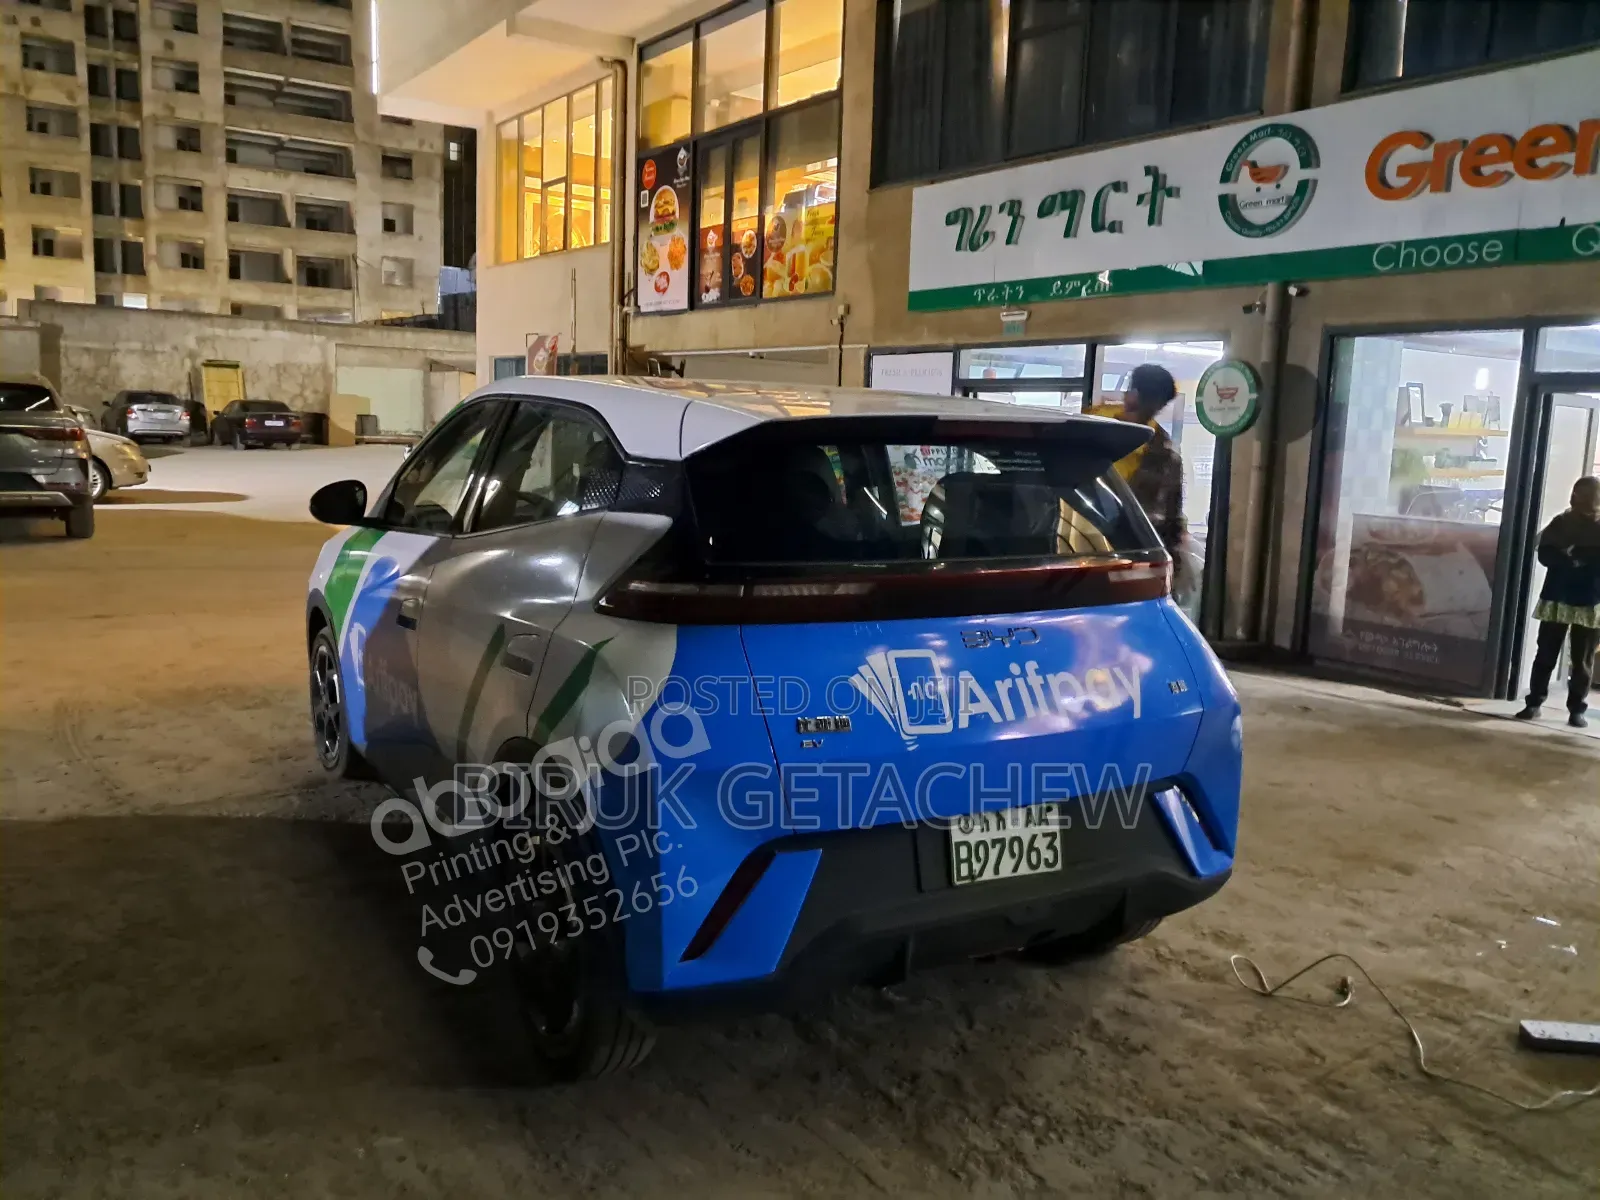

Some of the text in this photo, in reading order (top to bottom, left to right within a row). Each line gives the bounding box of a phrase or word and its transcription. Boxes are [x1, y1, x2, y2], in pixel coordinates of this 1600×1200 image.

[1037, 165, 1181, 239] ማርት
[1239, 199, 1263, 209] Green
[1372, 238, 1504, 272] Choose
[959, 626, 1041, 649] BYD
[958, 660, 1142, 729] Arifpay
[954, 831, 1060, 882] B97963
